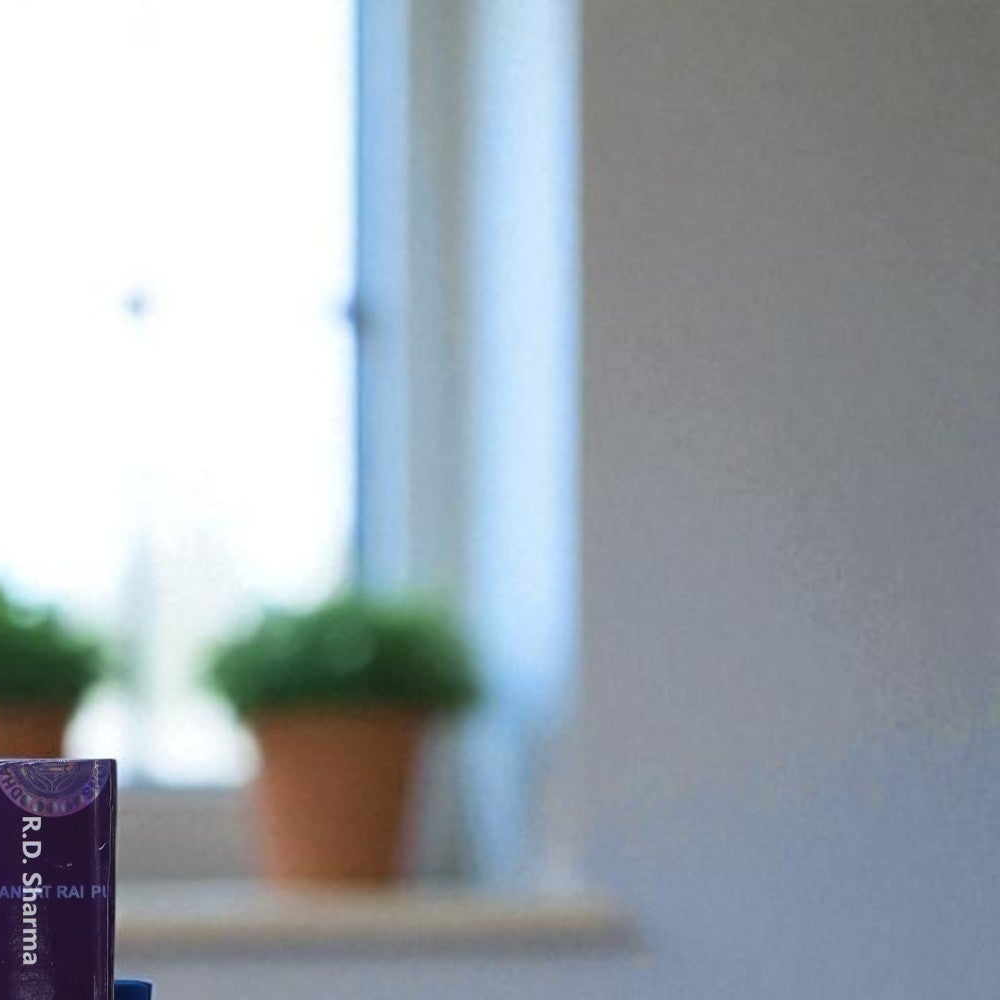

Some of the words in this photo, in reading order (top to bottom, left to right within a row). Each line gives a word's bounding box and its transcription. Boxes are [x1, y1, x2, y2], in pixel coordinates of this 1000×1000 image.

[21, 816, 42, 864] R.D.
[56, 885, 84, 898] RAI
[21, 872, 43, 965] Sharma
